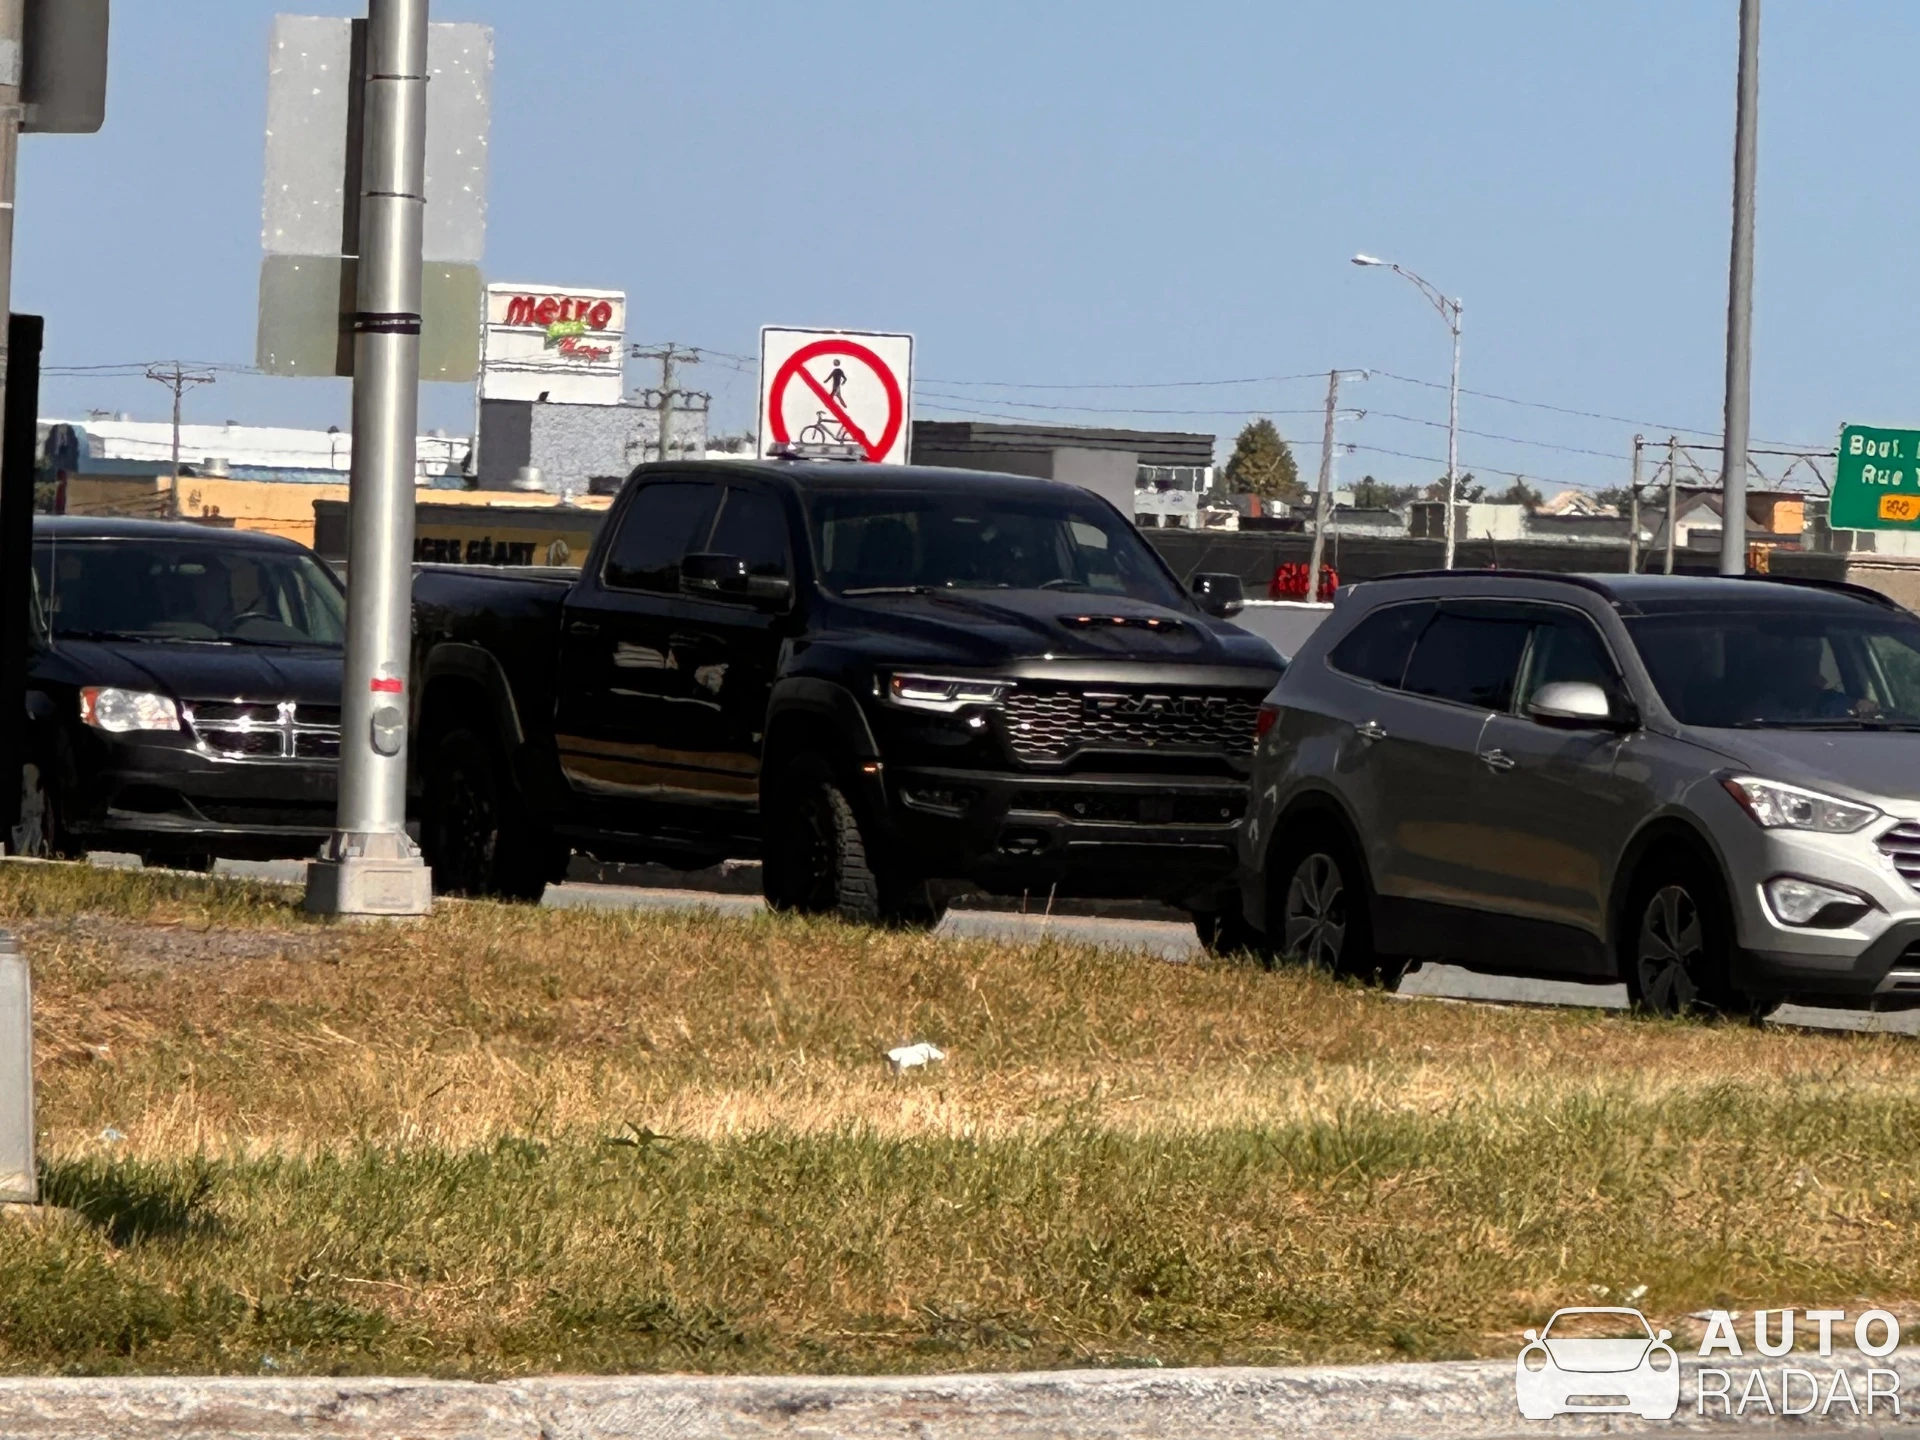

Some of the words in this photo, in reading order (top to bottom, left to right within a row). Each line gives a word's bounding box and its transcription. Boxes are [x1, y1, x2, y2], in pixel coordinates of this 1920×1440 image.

[504, 296, 612, 331] metro
[1850, 434, 1904, 458] Boul.
[1862, 464, 1903, 486] Rue
